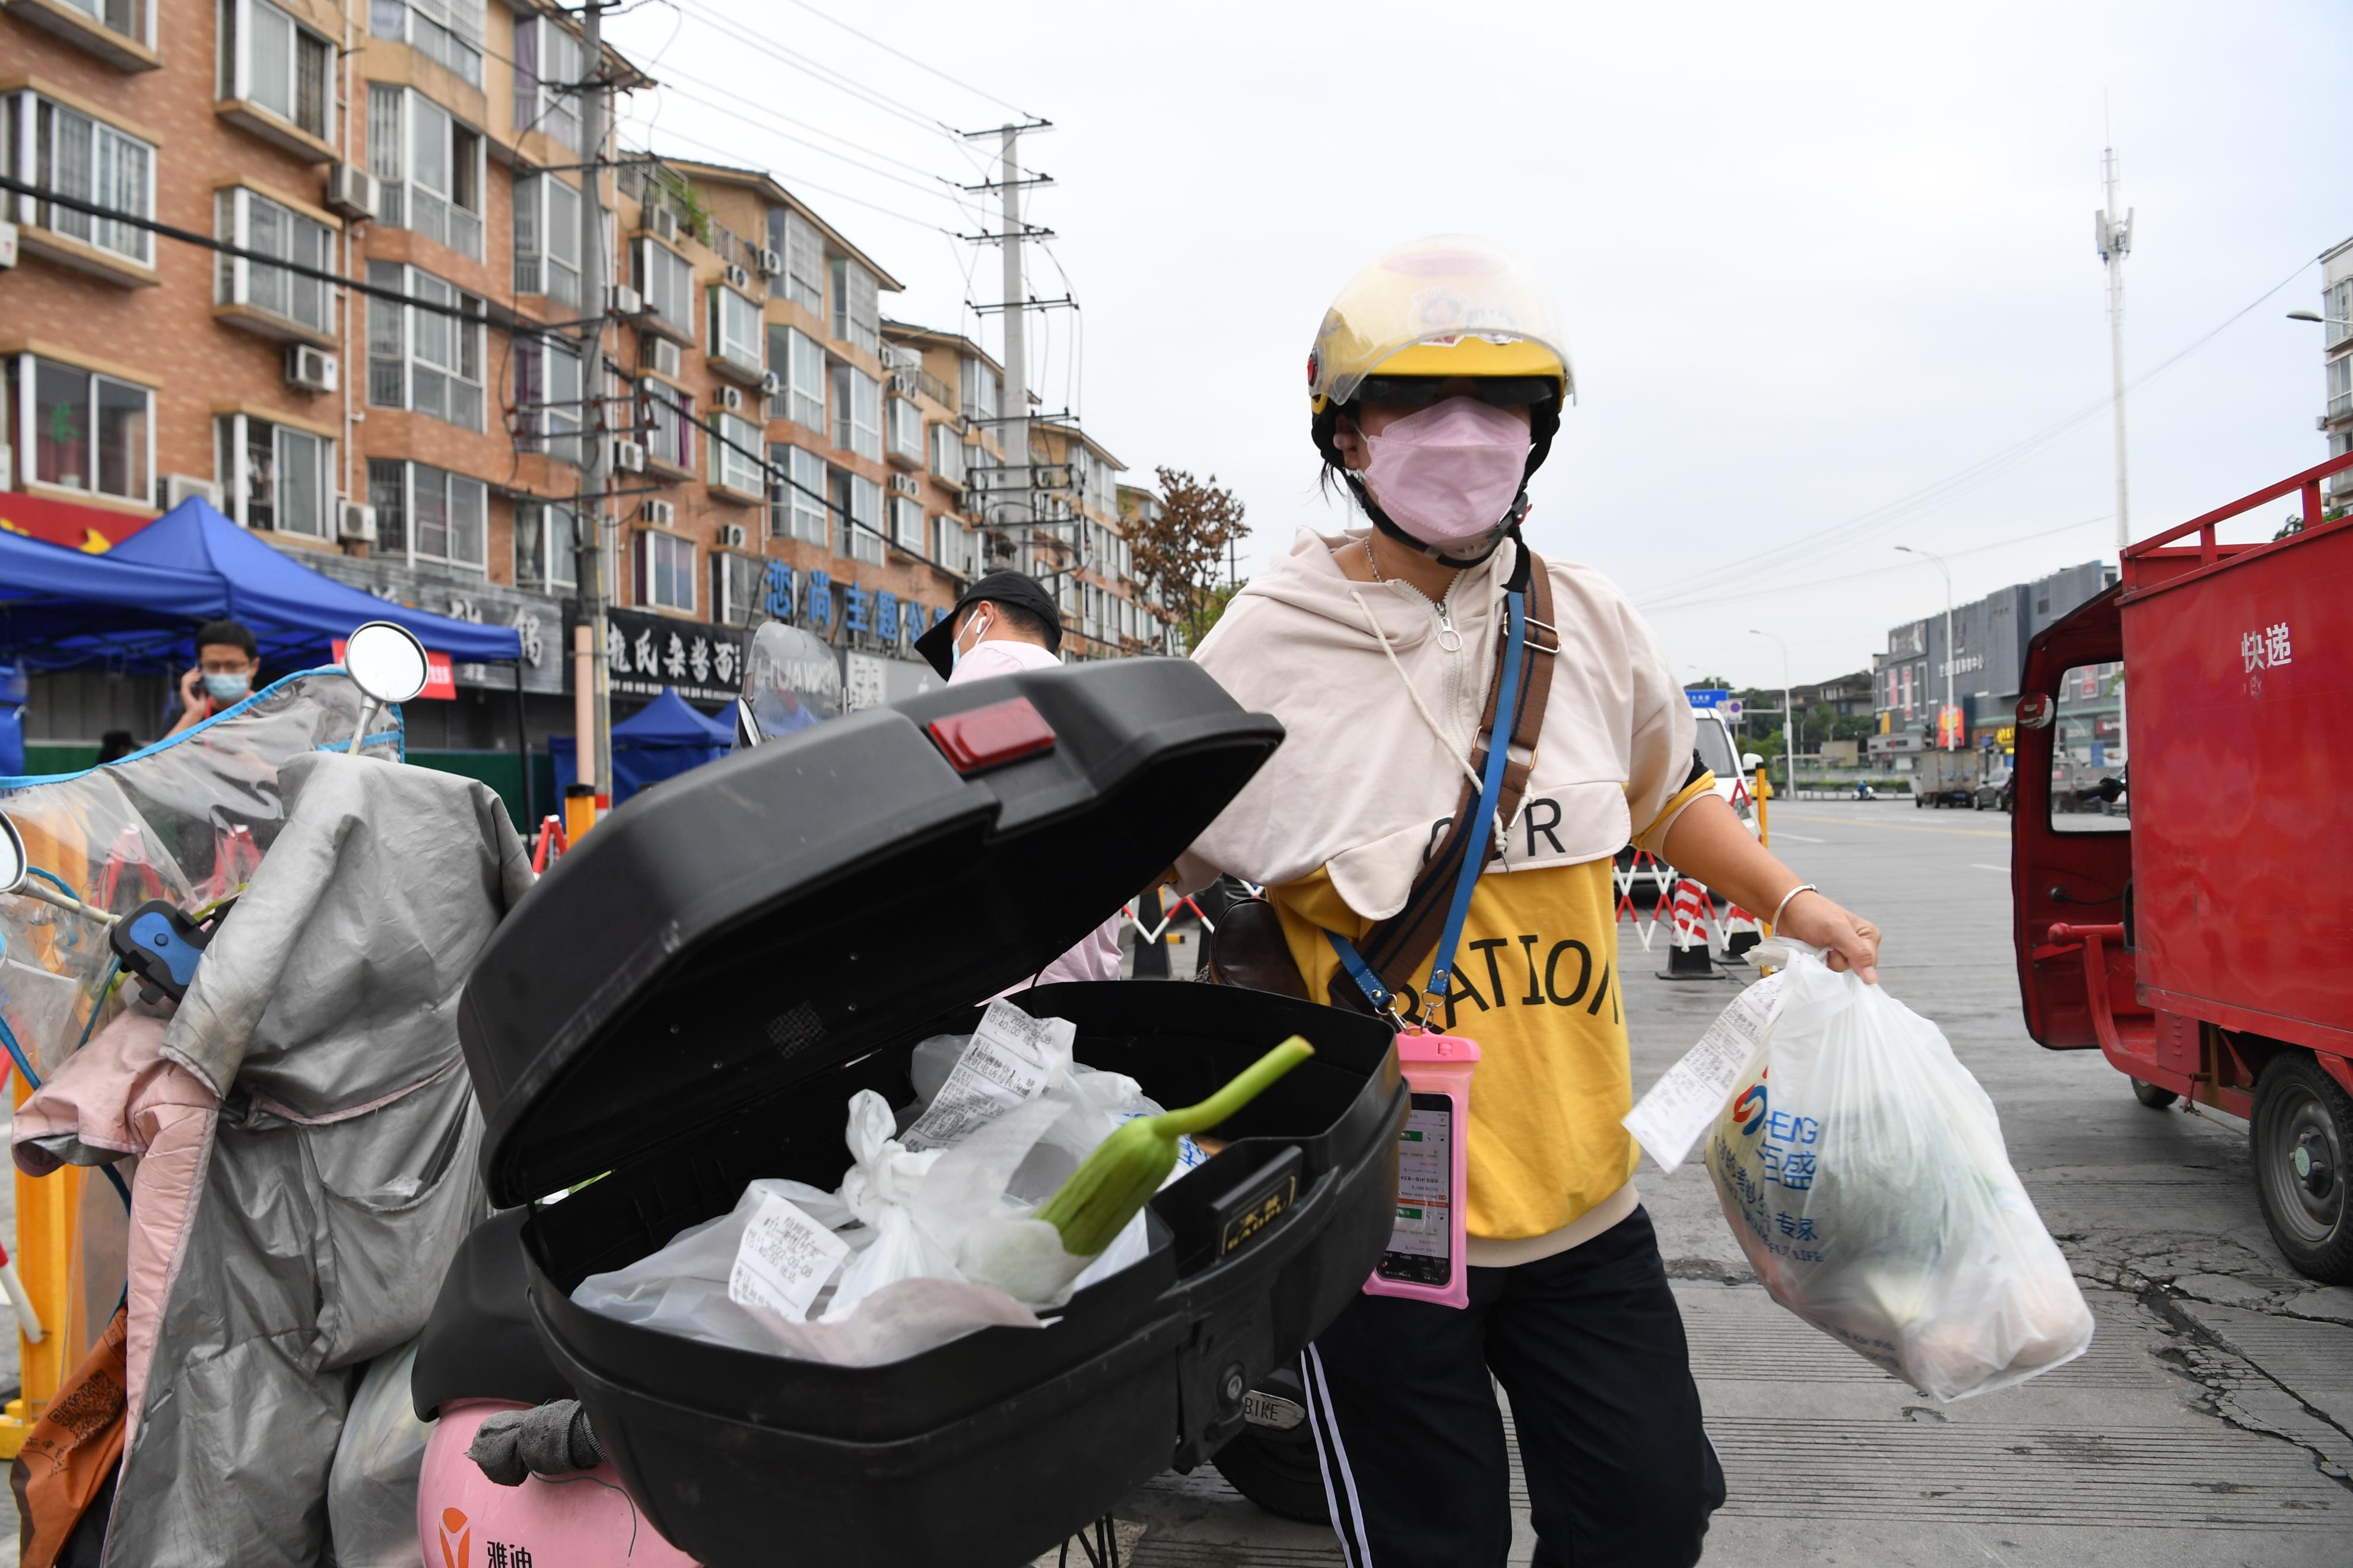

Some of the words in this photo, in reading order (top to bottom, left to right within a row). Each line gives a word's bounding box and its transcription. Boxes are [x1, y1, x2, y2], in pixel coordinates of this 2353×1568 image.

[766, 558, 951, 642] 恋尚主题公
[2241, 622, 2291, 673] 快递
[986, 1013, 1021, 1037] 10:40:00
[1775, 1210, 1818, 1241] 专家
[1244, 1397, 1278, 1421] BIKE
